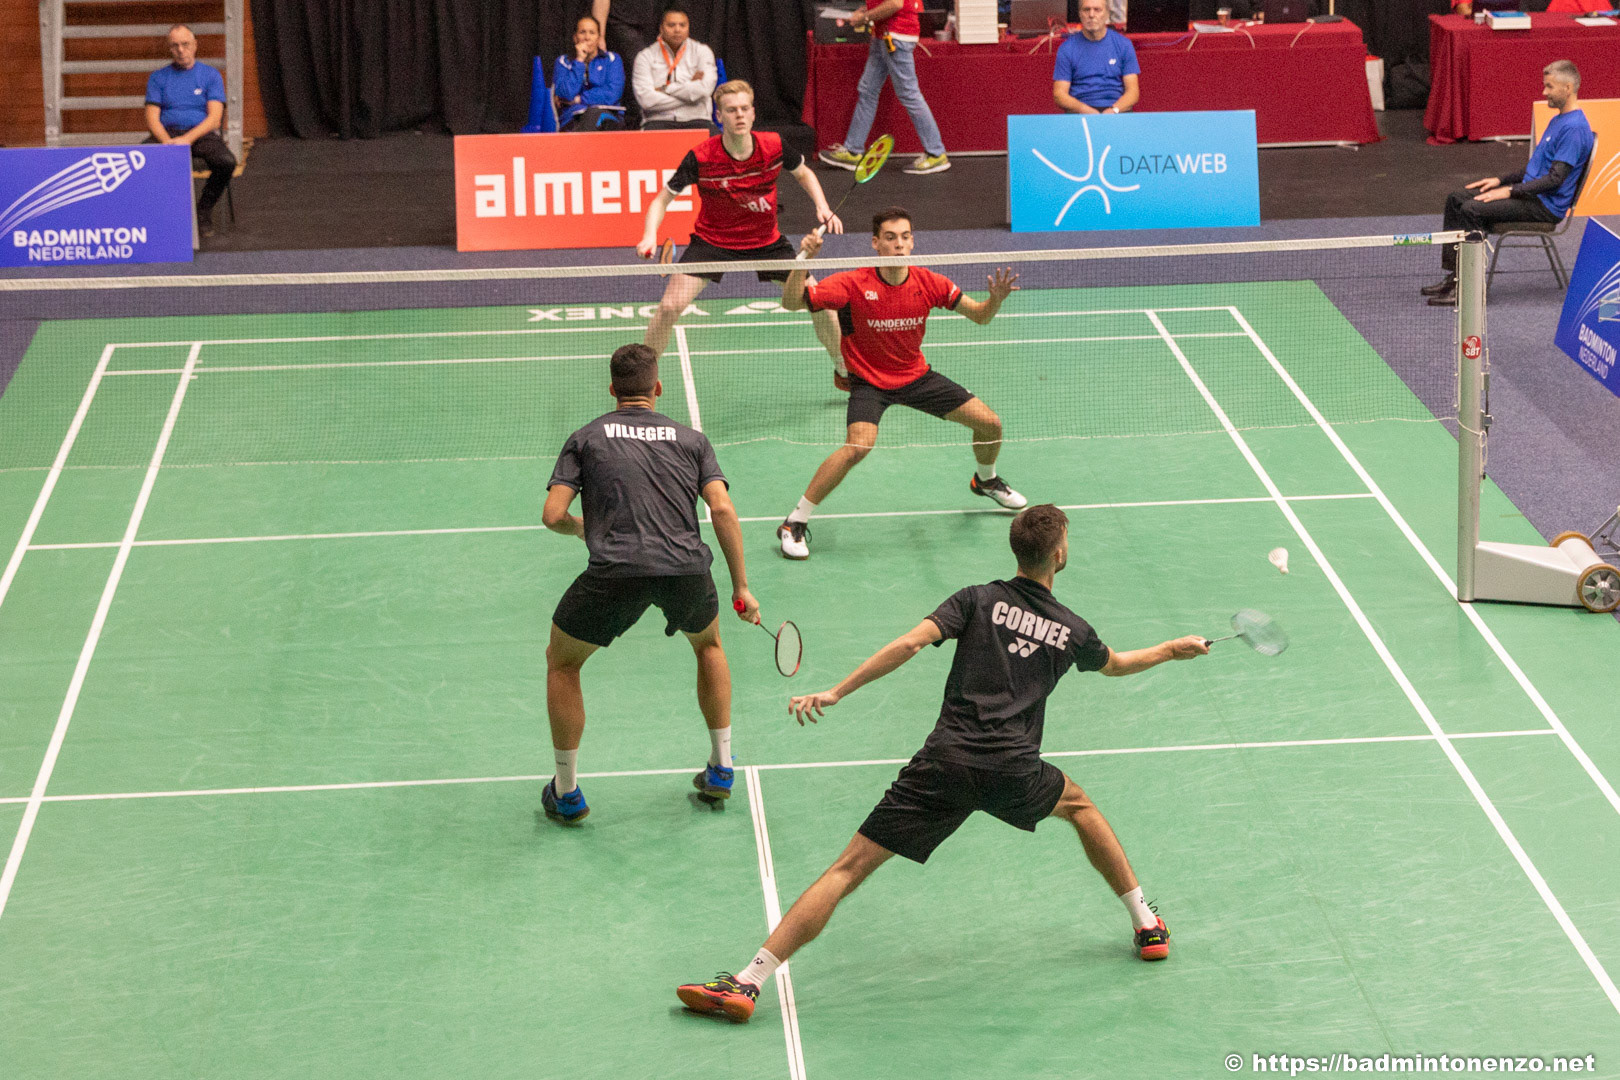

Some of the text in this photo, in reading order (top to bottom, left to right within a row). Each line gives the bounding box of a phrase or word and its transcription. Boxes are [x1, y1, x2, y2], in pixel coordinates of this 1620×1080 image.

[1120, 153, 1228, 175] DATAWEB
[740, 196, 772, 213] BA
[13, 226, 147, 247] BADMINTON
[28, 244, 134, 261] NEDERLAND
[864, 290, 878, 300] CBA
[867, 316, 924, 328] VANDEKOLK
[1465, 347, 1481, 357] SBT
[1578, 323, 1617, 367] BADMINTON
[603, 422, 677, 442] VILLEGER
[991, 600, 1071, 651] CORVEE
